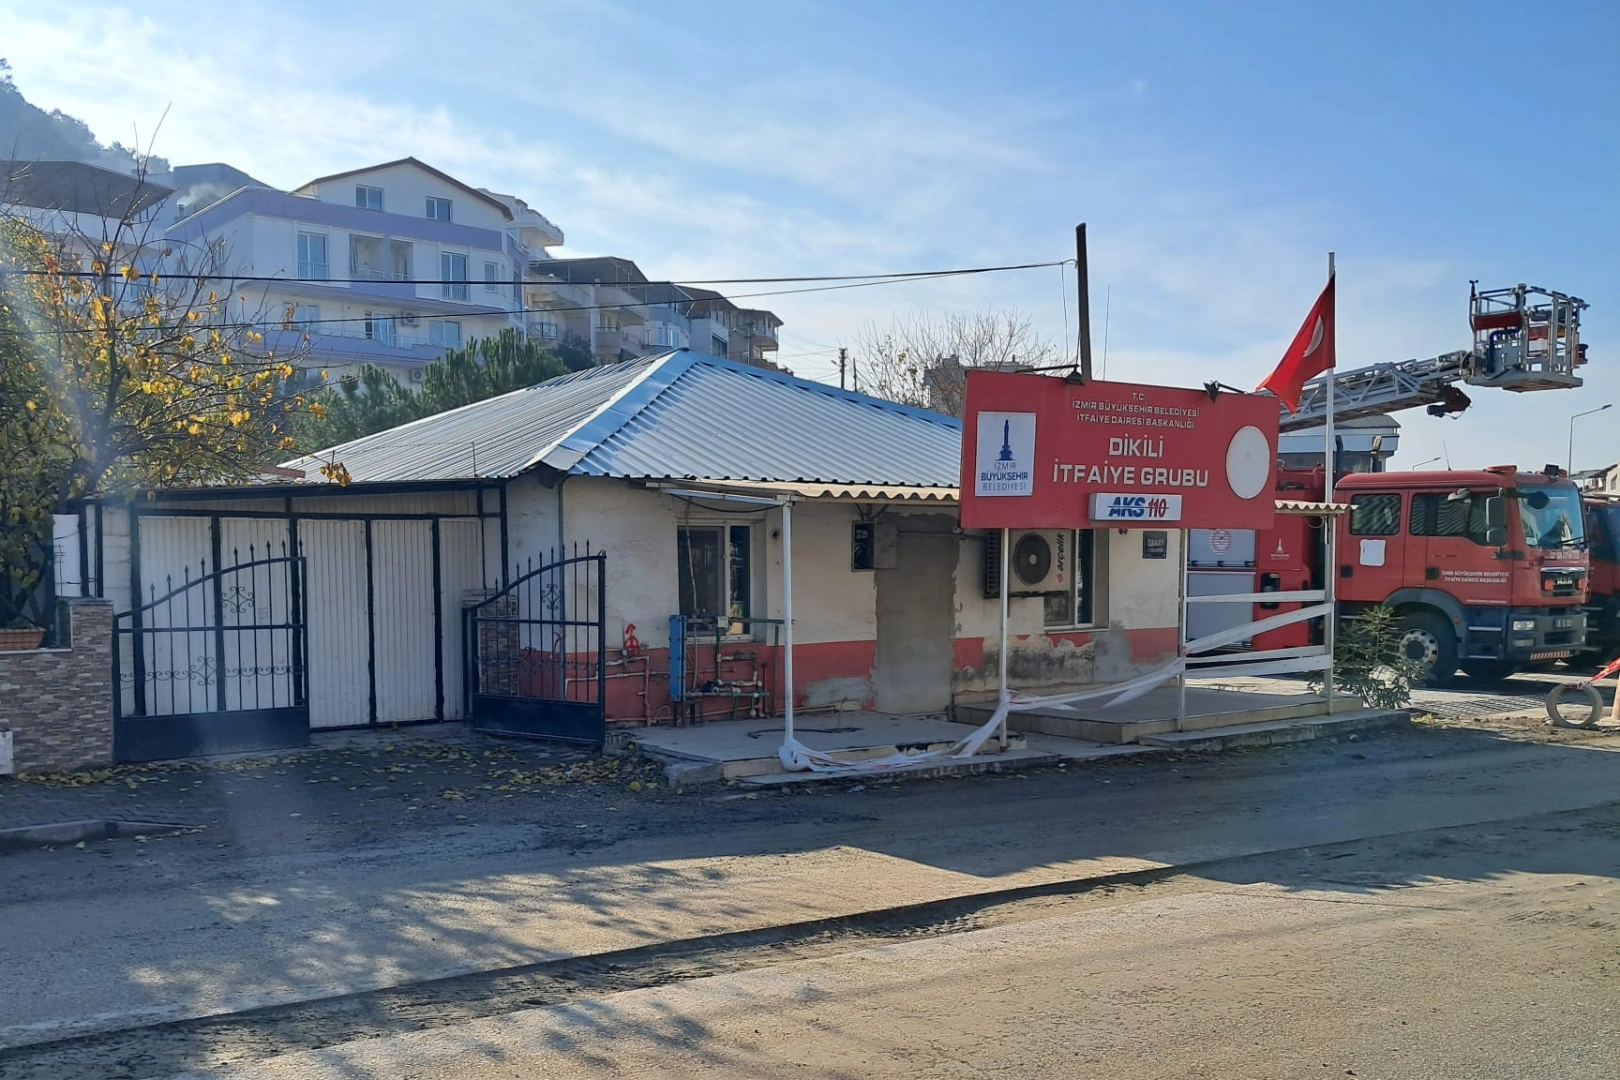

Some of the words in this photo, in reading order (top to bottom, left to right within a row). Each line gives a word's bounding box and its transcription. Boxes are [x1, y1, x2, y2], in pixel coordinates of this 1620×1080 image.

[1072, 398, 1097, 409] İZMİR
[1154, 406, 1200, 417] BELEDİYESİ
[1077, 411, 1110, 423] İTFAİYE
[1111, 414, 1145, 426] DAİRESİ
[1109, 433, 1164, 458] DİKİLİ
[1052, 458, 1136, 485] İTFAİYE
[1140, 467, 1209, 487] GRUBU
[1108, 496, 1146, 518] AKS
[1147, 498, 1168, 518] 110
[1056, 532, 1066, 572] arçelik
